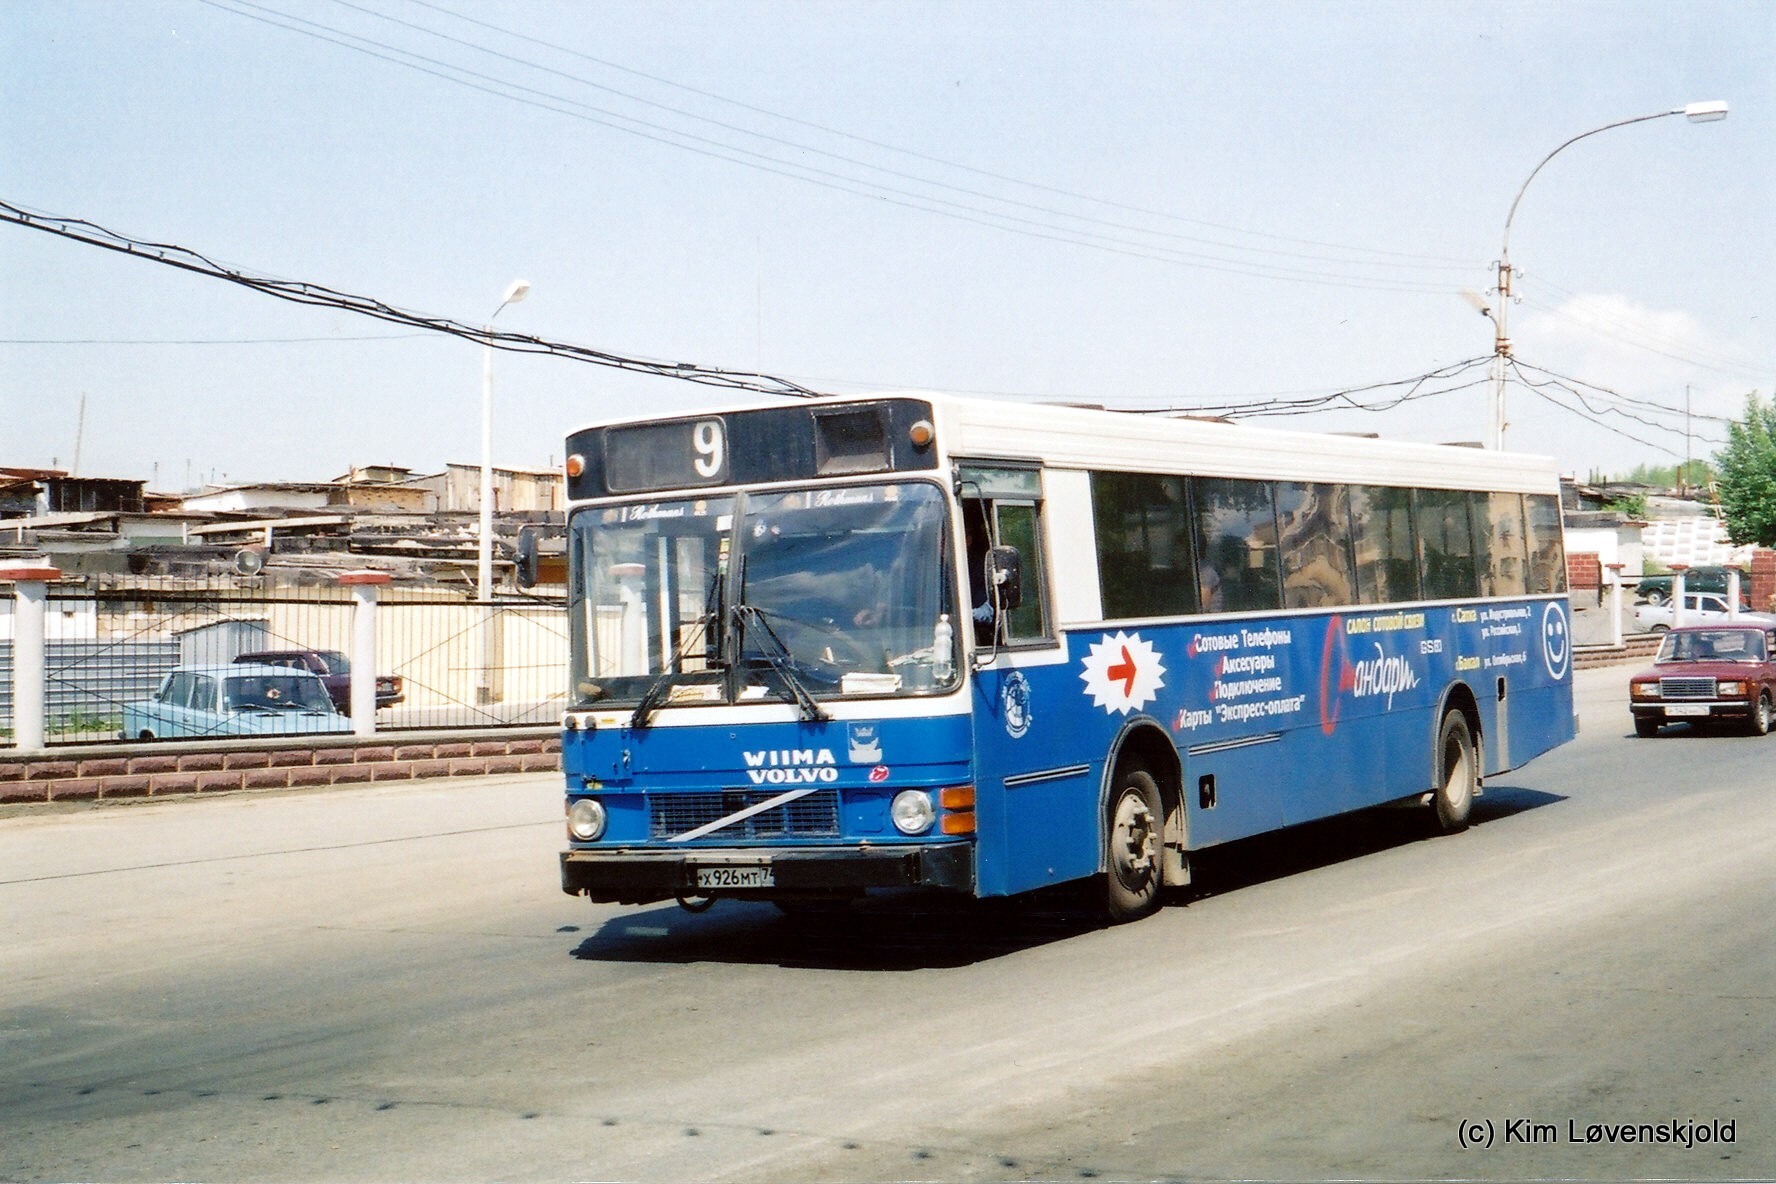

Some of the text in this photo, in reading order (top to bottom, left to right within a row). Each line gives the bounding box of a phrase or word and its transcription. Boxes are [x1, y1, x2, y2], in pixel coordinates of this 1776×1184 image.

[693, 422, 724, 478] 9
[814, 491, 874, 508] Rothmans
[1194, 627, 1292, 653] Сотовые Телефоны
[1222, 654, 1275, 675] Аксесуары
[1213, 676, 1282, 700] Подключение
[1179, 708, 1213, 731] Карты
[742, 748, 835, 767] WIIMA
[745, 767, 838, 784] VOLVO
